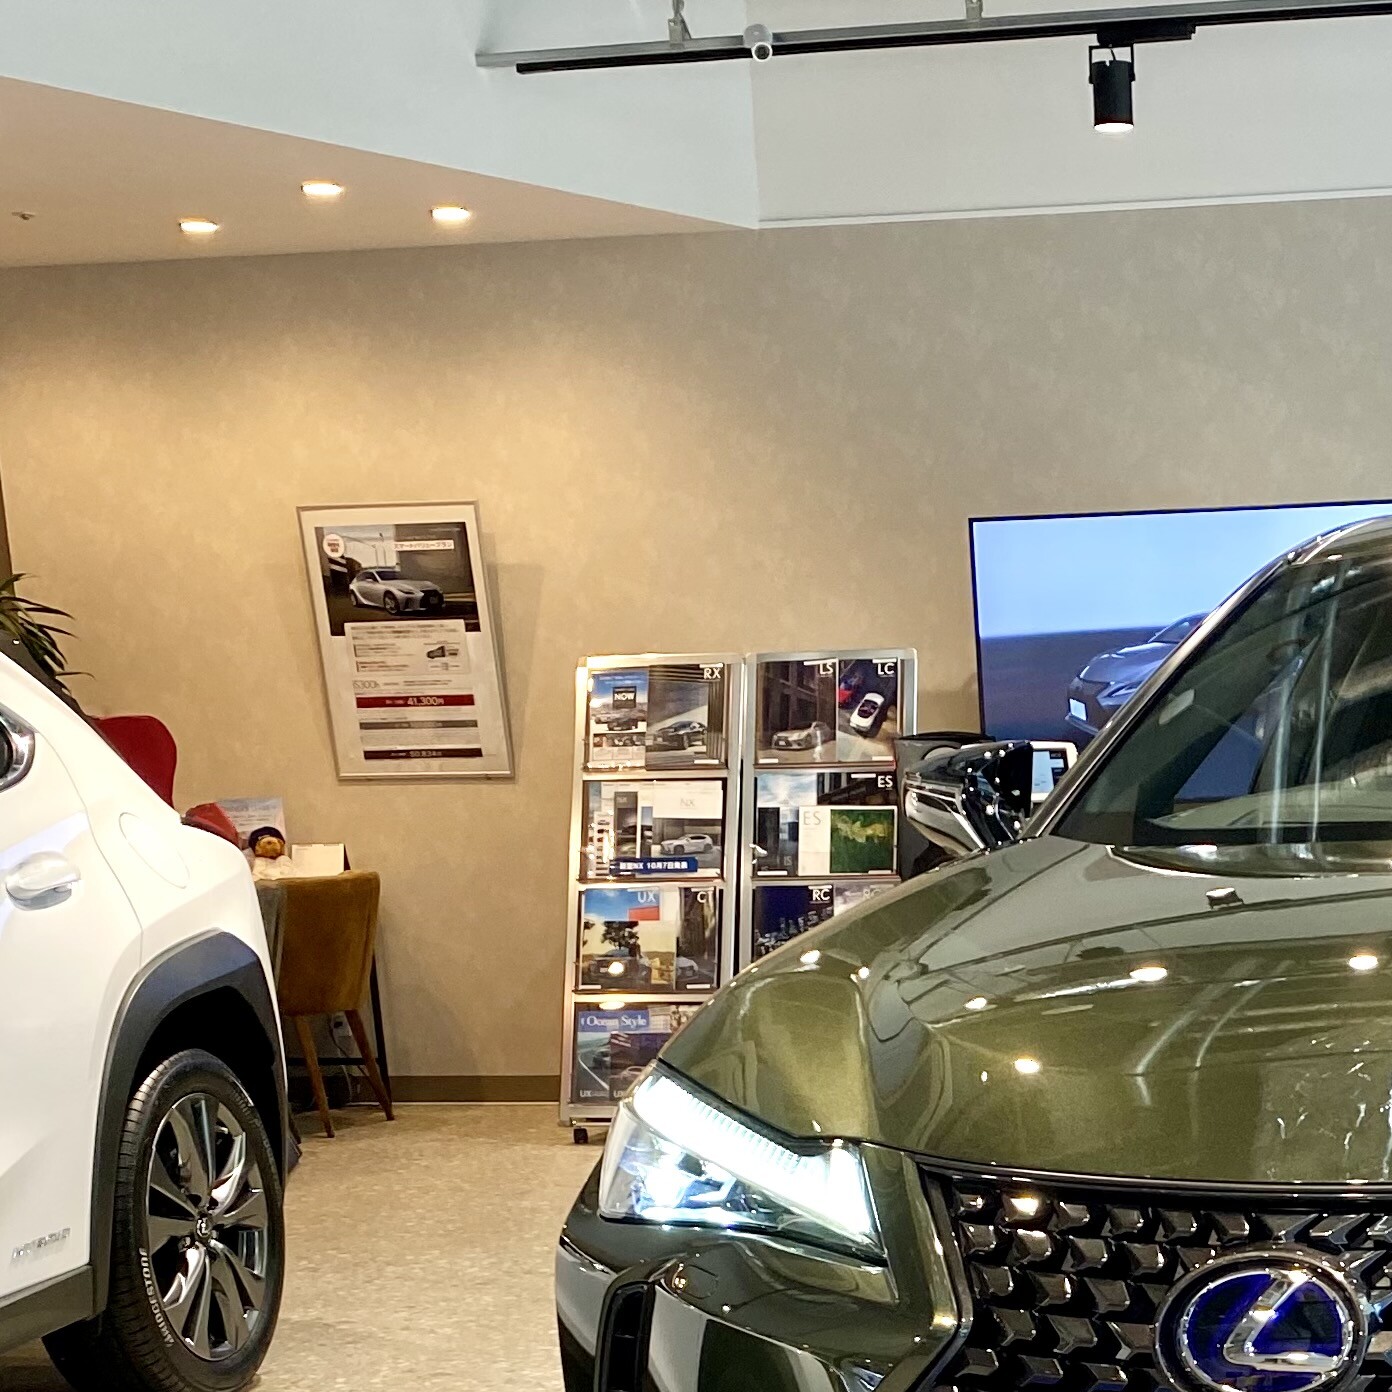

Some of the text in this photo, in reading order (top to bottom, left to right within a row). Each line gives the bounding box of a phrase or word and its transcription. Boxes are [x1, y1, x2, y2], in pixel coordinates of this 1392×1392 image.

[703, 668, 721, 680] RX
[819, 663, 834, 675] LS
[877, 663, 895, 675] LC
[614, 692, 635, 701] NOW
[877, 775, 893, 788] ES
[803, 811, 822, 826] ES
[637, 891, 657, 903] UX
[812, 889, 831, 901] RC
[621, 1014, 647, 1029] Style
[579, 1089, 592, 1098] UX
